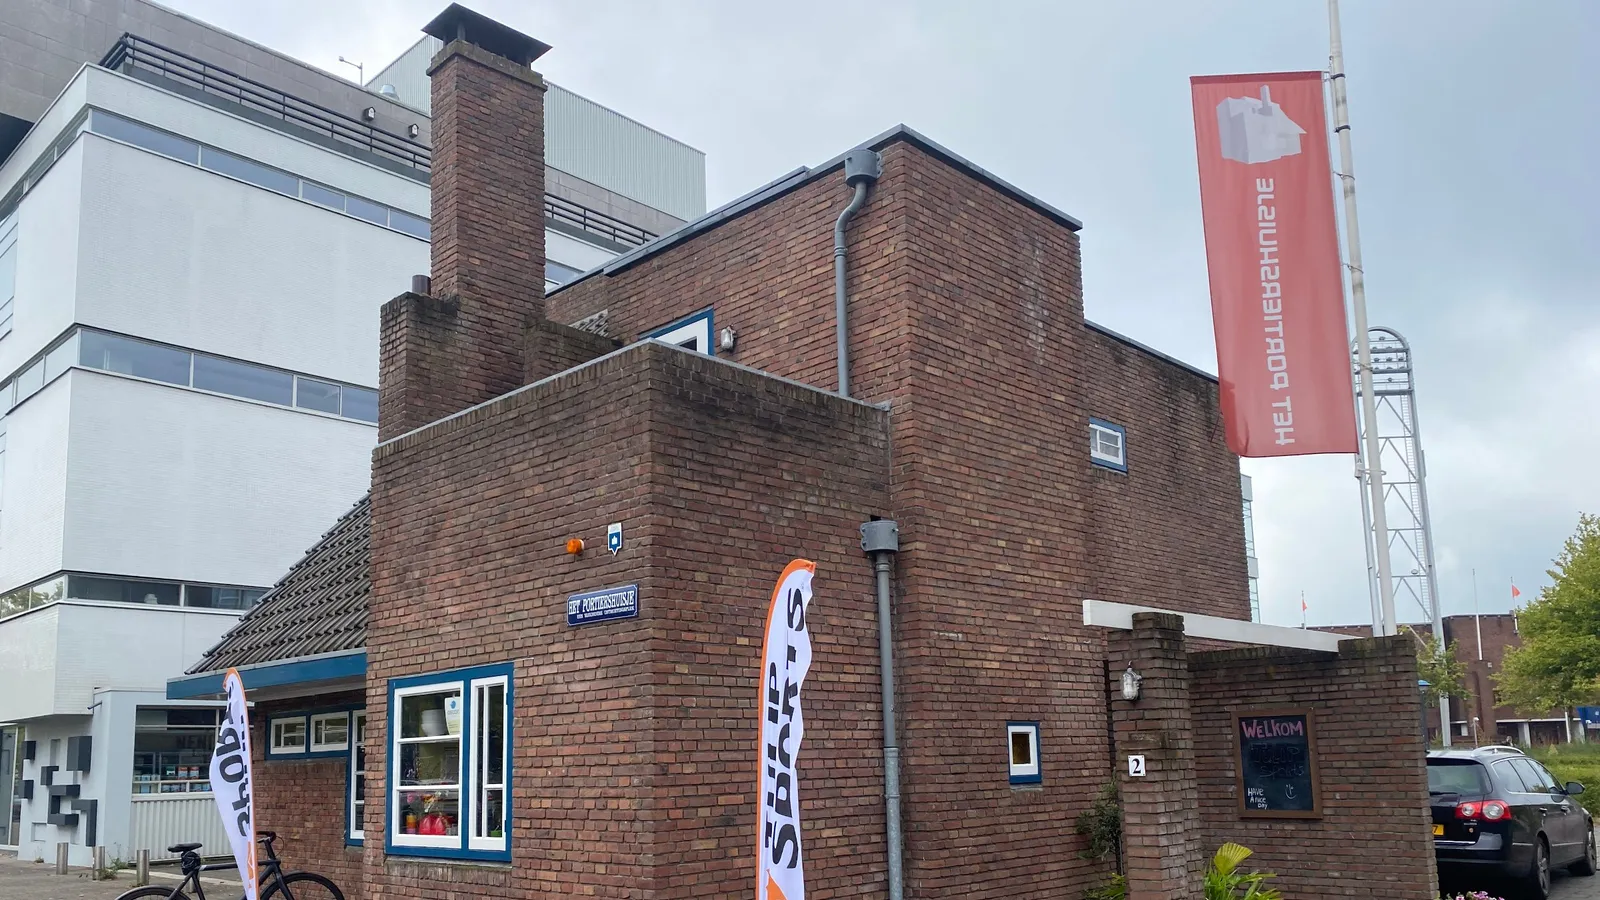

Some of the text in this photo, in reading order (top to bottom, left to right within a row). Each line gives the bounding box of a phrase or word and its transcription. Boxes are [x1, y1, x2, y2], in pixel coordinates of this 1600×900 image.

[569, 600, 580, 614] HET
[582, 591, 634, 612] PORTIERSHUISJE
[1241, 719, 1304, 739] WELKOM
[1131, 758, 1142, 774] 2
